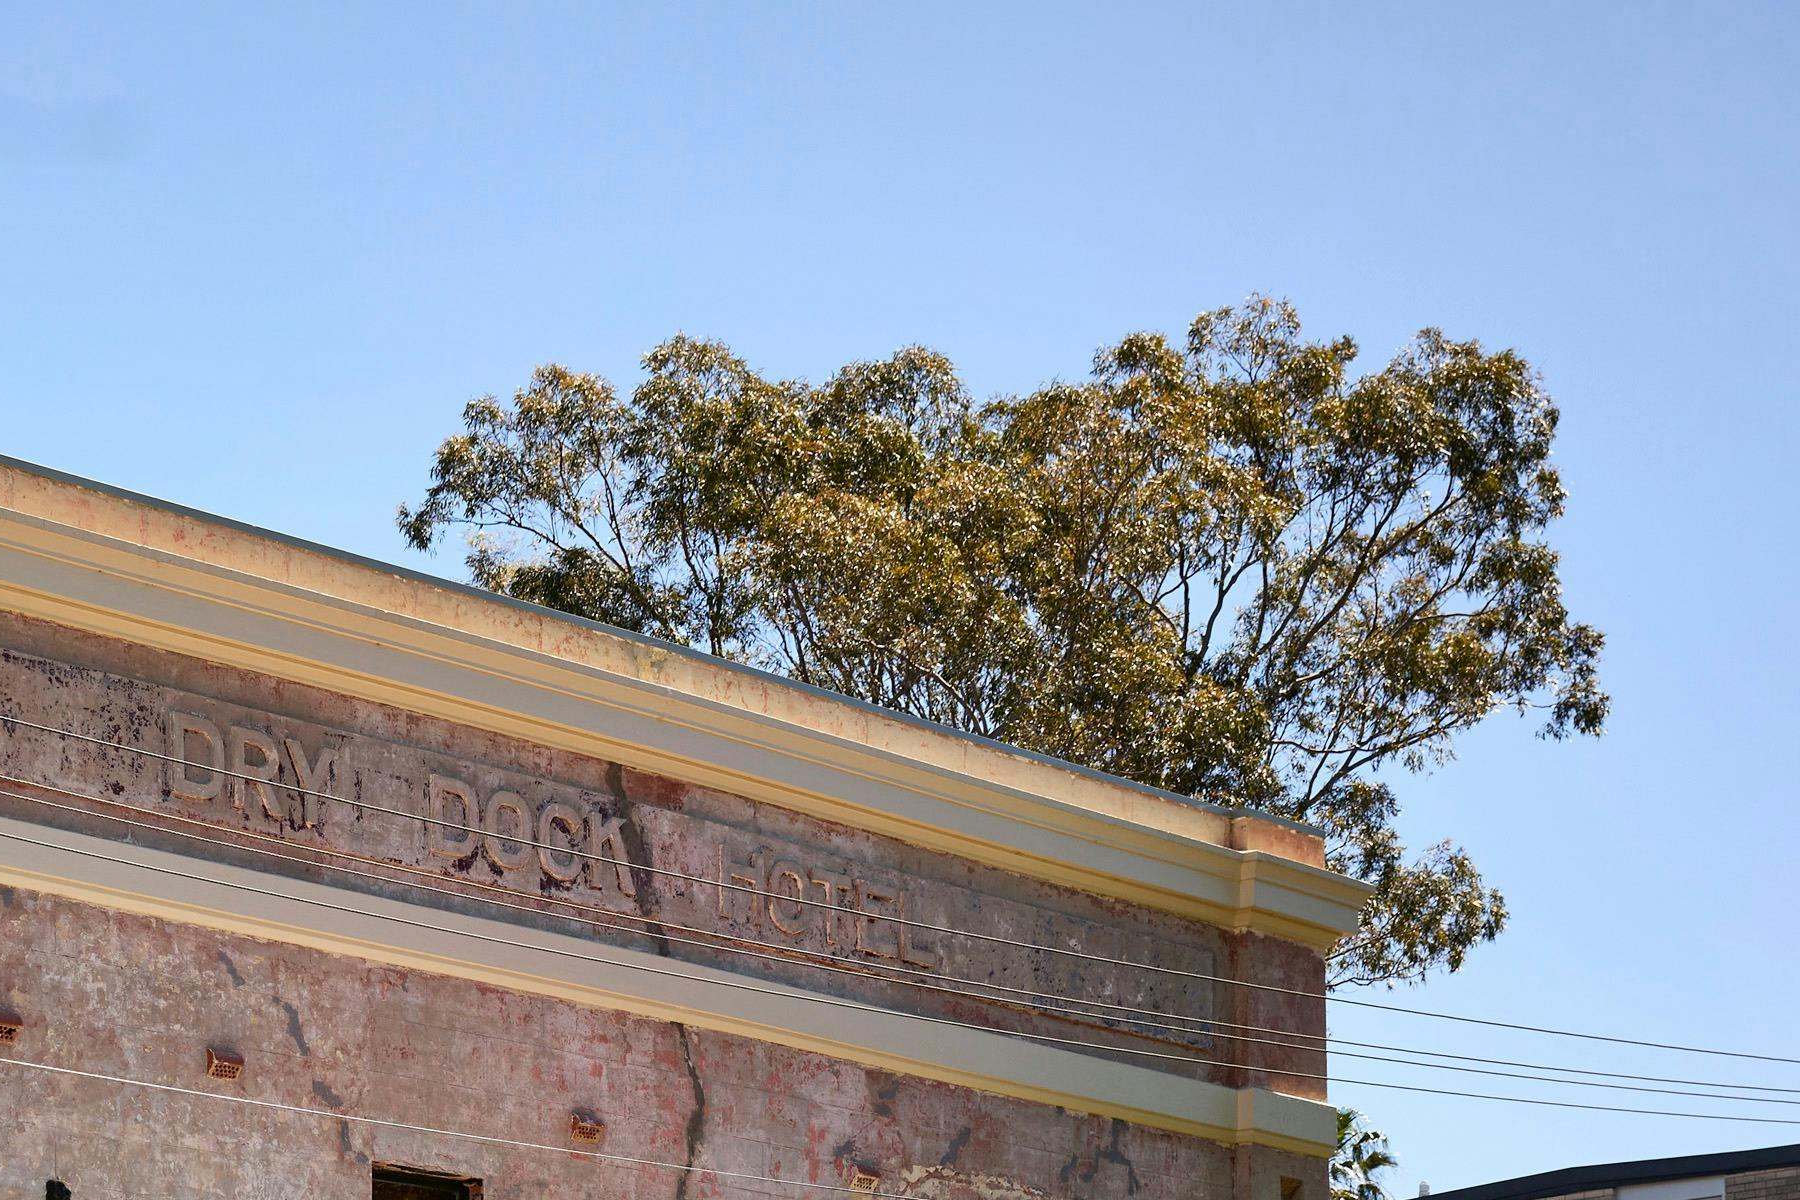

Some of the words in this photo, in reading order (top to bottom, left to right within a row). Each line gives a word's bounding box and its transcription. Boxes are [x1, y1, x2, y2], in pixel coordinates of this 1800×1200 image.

[171, 711, 338, 829] DRY
[429, 773, 637, 898] DOCK
[717, 844, 938, 969] HOTEL
